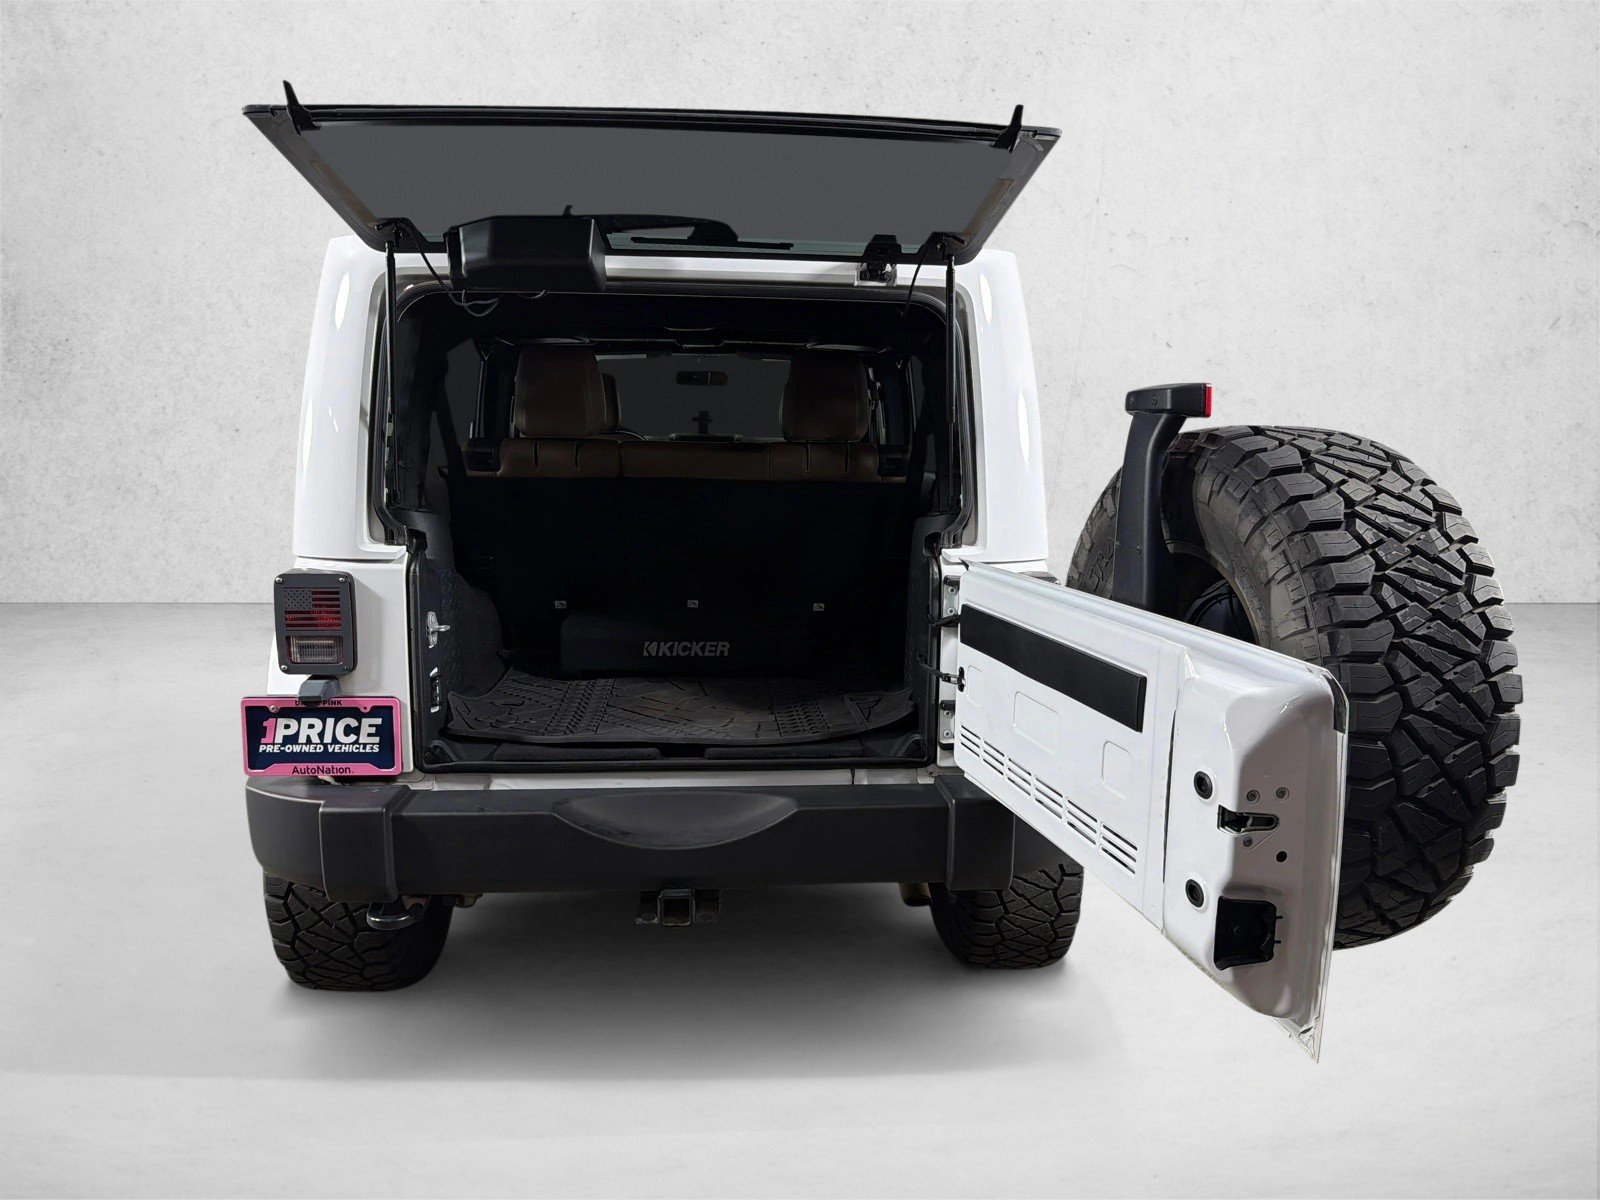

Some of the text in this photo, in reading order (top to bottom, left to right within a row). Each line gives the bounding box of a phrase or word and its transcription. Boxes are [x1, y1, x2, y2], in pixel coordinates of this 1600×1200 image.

[658, 641, 730, 657] KICKER
[259, 744, 380, 753] PRE-OWNED VEHICLES
[291, 765, 351, 775] AutoNation
